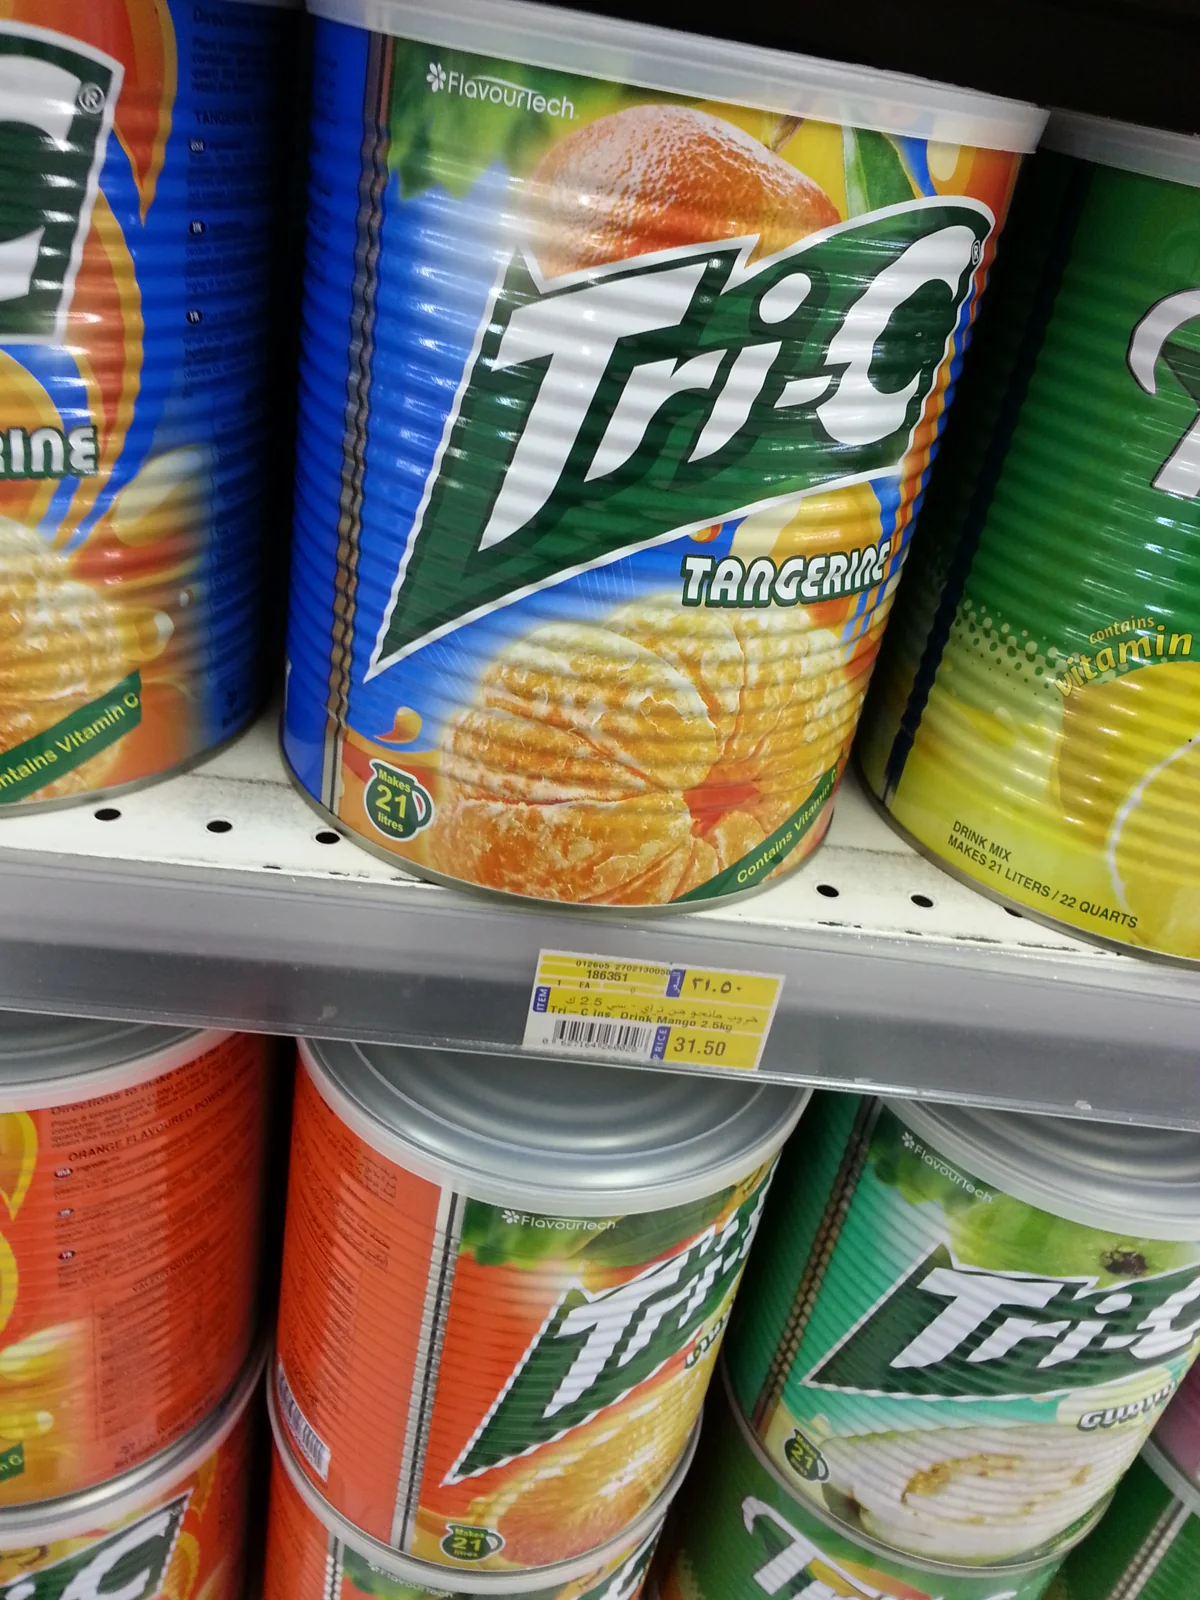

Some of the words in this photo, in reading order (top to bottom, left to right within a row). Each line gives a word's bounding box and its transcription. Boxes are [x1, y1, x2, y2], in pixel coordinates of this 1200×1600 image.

[448, 71, 575, 120] FlavourTech
[478, 224, 977, 553] Tri-C
[683, 542, 891, 606] TANGERINE
[1089, 615, 1155, 645] contains
[1055, 624, 1193, 698] vitamin
[55, 705, 125, 752] Vitamin
[123, 692, 139, 708] C
[378, 768, 411, 793] Makes
[375, 784, 407, 819] 21
[377, 811, 404, 833] litres
[737, 830, 793, 883] Contains
[793, 784, 830, 831] Vitamin
[952, 820, 988, 850] DRINK
[989, 842, 1012, 862] MIX
[947, 834, 992, 866] MAKES
[988, 859, 1003, 874] 21
[1004, 867, 1051, 897] LITERS
[1059, 894, 1077, 908] 22
[1079, 901, 1138, 929] QUARTS
[586, 969, 628, 982] 186351
[536, 988, 548, 1012] ITEM
[620, 1011, 652, 1023] Drink
[657, 1014, 697, 1028] Mango
[652, 1028, 668, 1060] PRICE
[673, 1036, 727, 1057] 31.50
[914, 1145, 993, 1204] FlavourTech
[520, 1214, 617, 1232] FlavourTech
[791, 1443, 814, 1470] 21
[452, 1536, 482, 1552] 21
